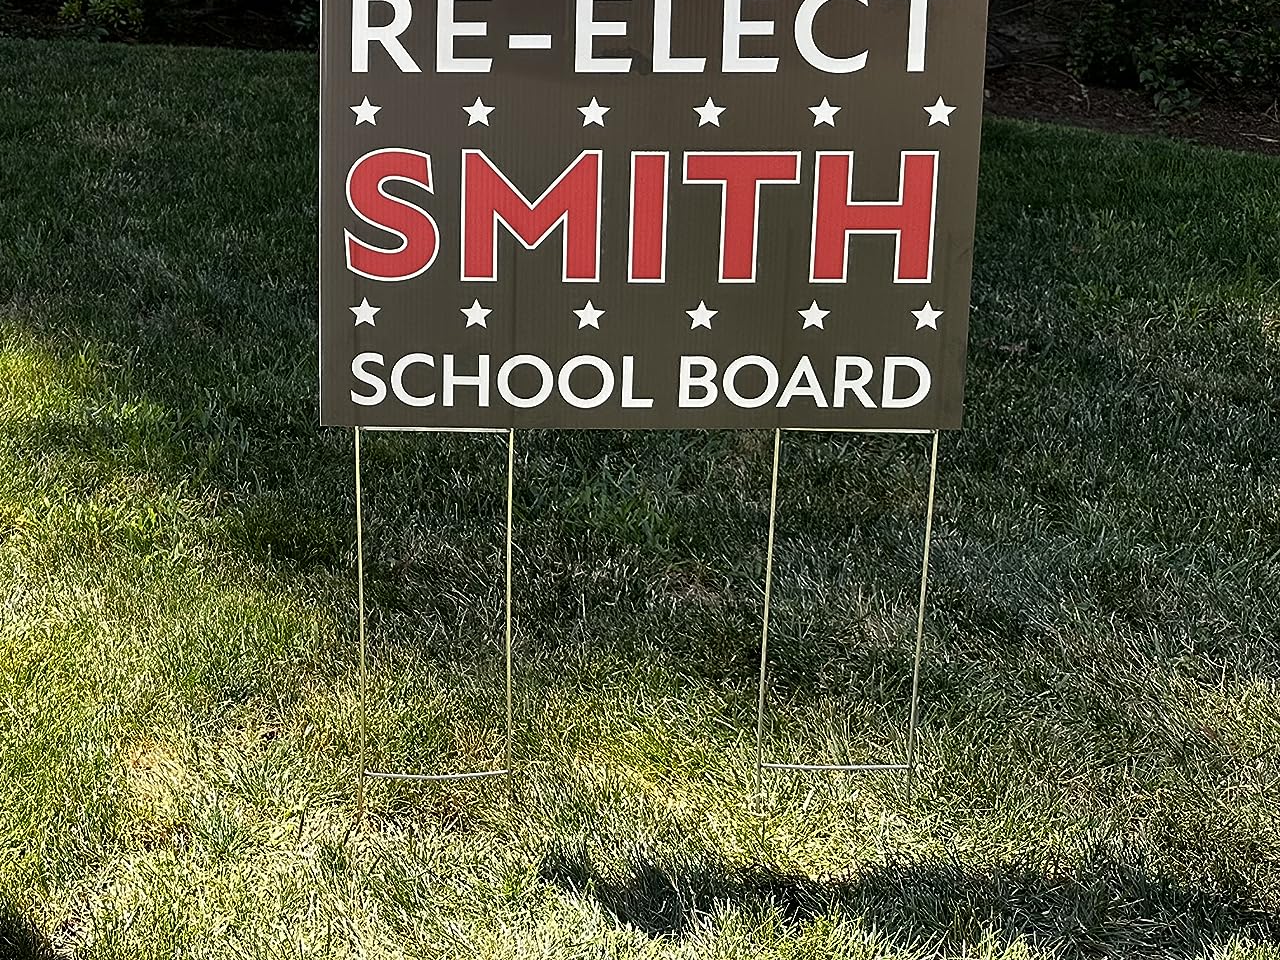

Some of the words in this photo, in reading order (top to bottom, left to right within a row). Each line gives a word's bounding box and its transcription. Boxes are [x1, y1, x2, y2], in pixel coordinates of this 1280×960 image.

[342, 146, 941, 284] SMITH
[349, 353, 654, 409] SCHOOL
[677, 355, 931, 409] BOARD
